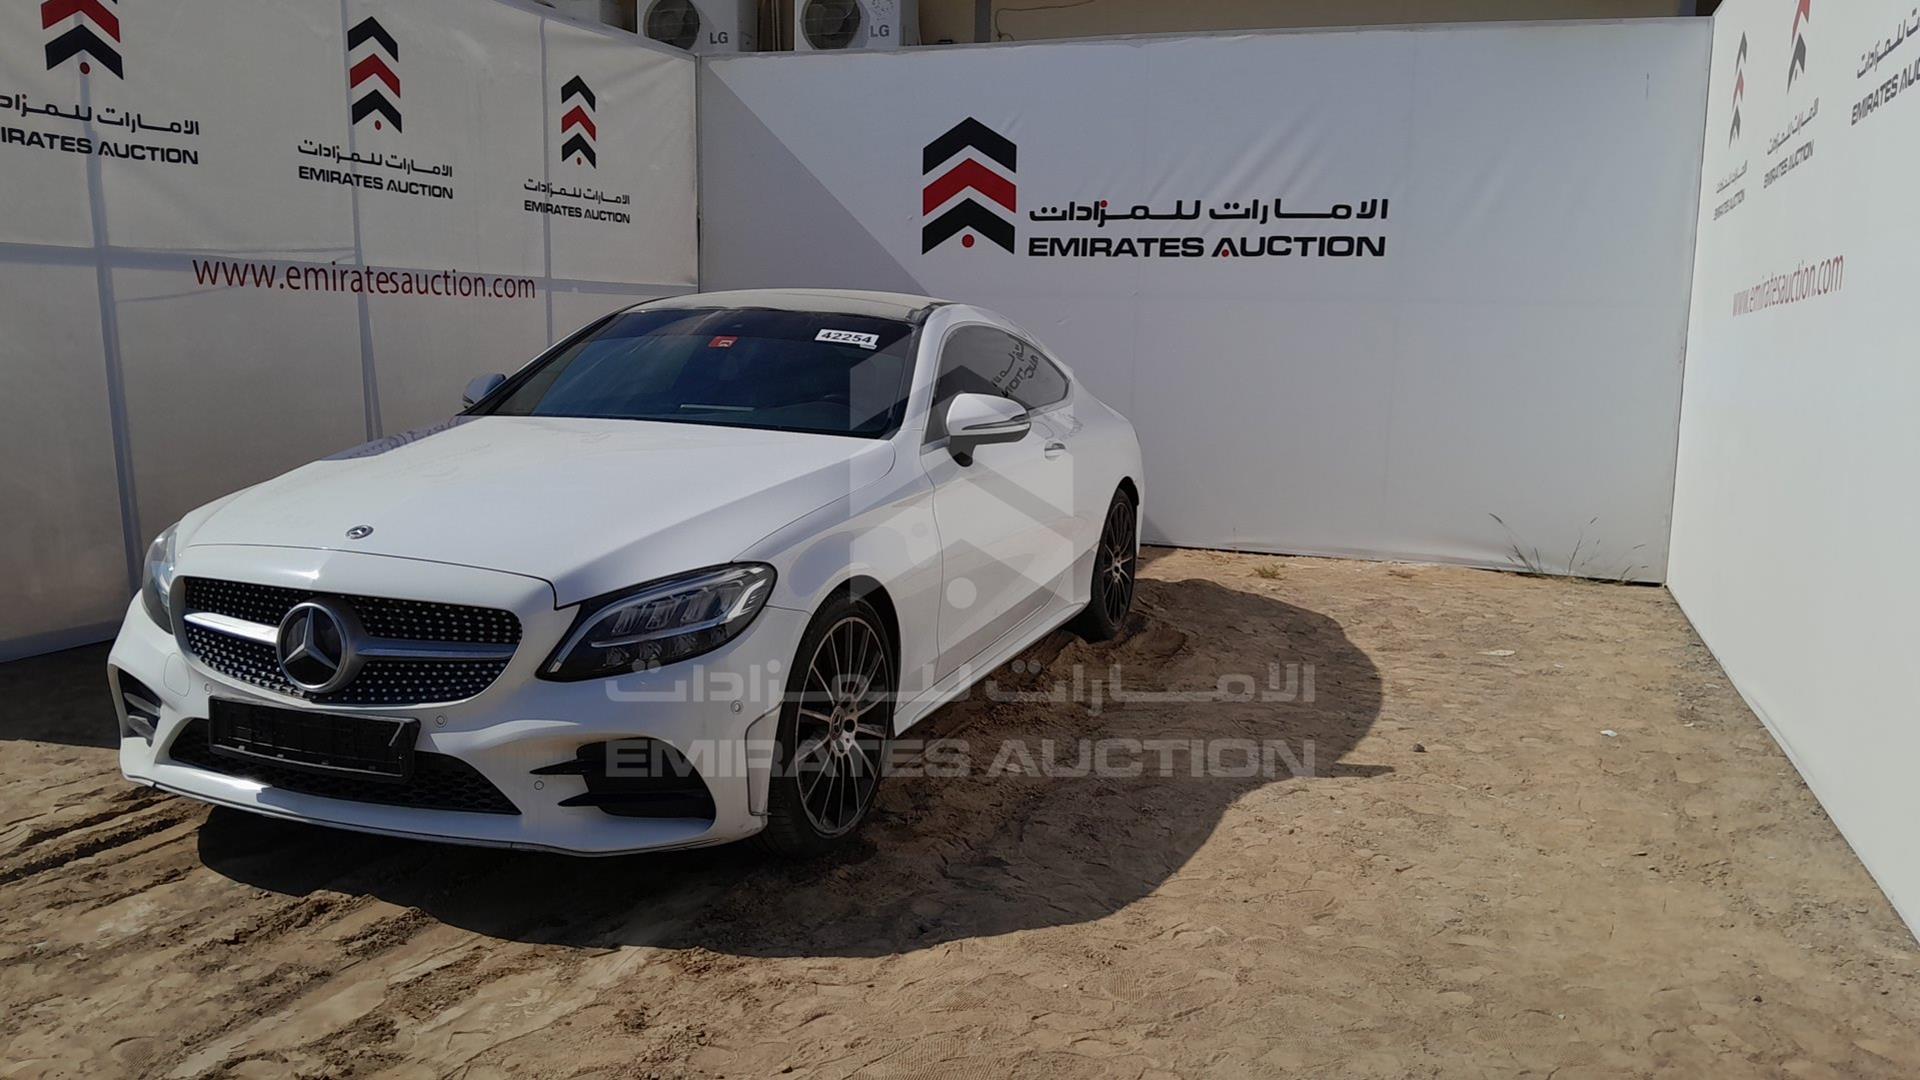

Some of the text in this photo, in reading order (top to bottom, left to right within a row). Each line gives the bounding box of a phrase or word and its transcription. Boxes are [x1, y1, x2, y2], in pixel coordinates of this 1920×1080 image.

[710, 31, 728, 44] LG
[870, 24, 890, 38] LG
[1851, 74, 1899, 126] EMIRATES
[98, 141, 198, 165] AUCTION
[298, 165, 453, 199] EMIRATES AUCTION
[524, 199, 631, 224] EMIRATES AUCTION
[1028, 235, 1386, 257] EMIRATES AUCTION
[192, 258, 536, 299] www.emiratesauction.com
[821, 331, 873, 343] 42254
